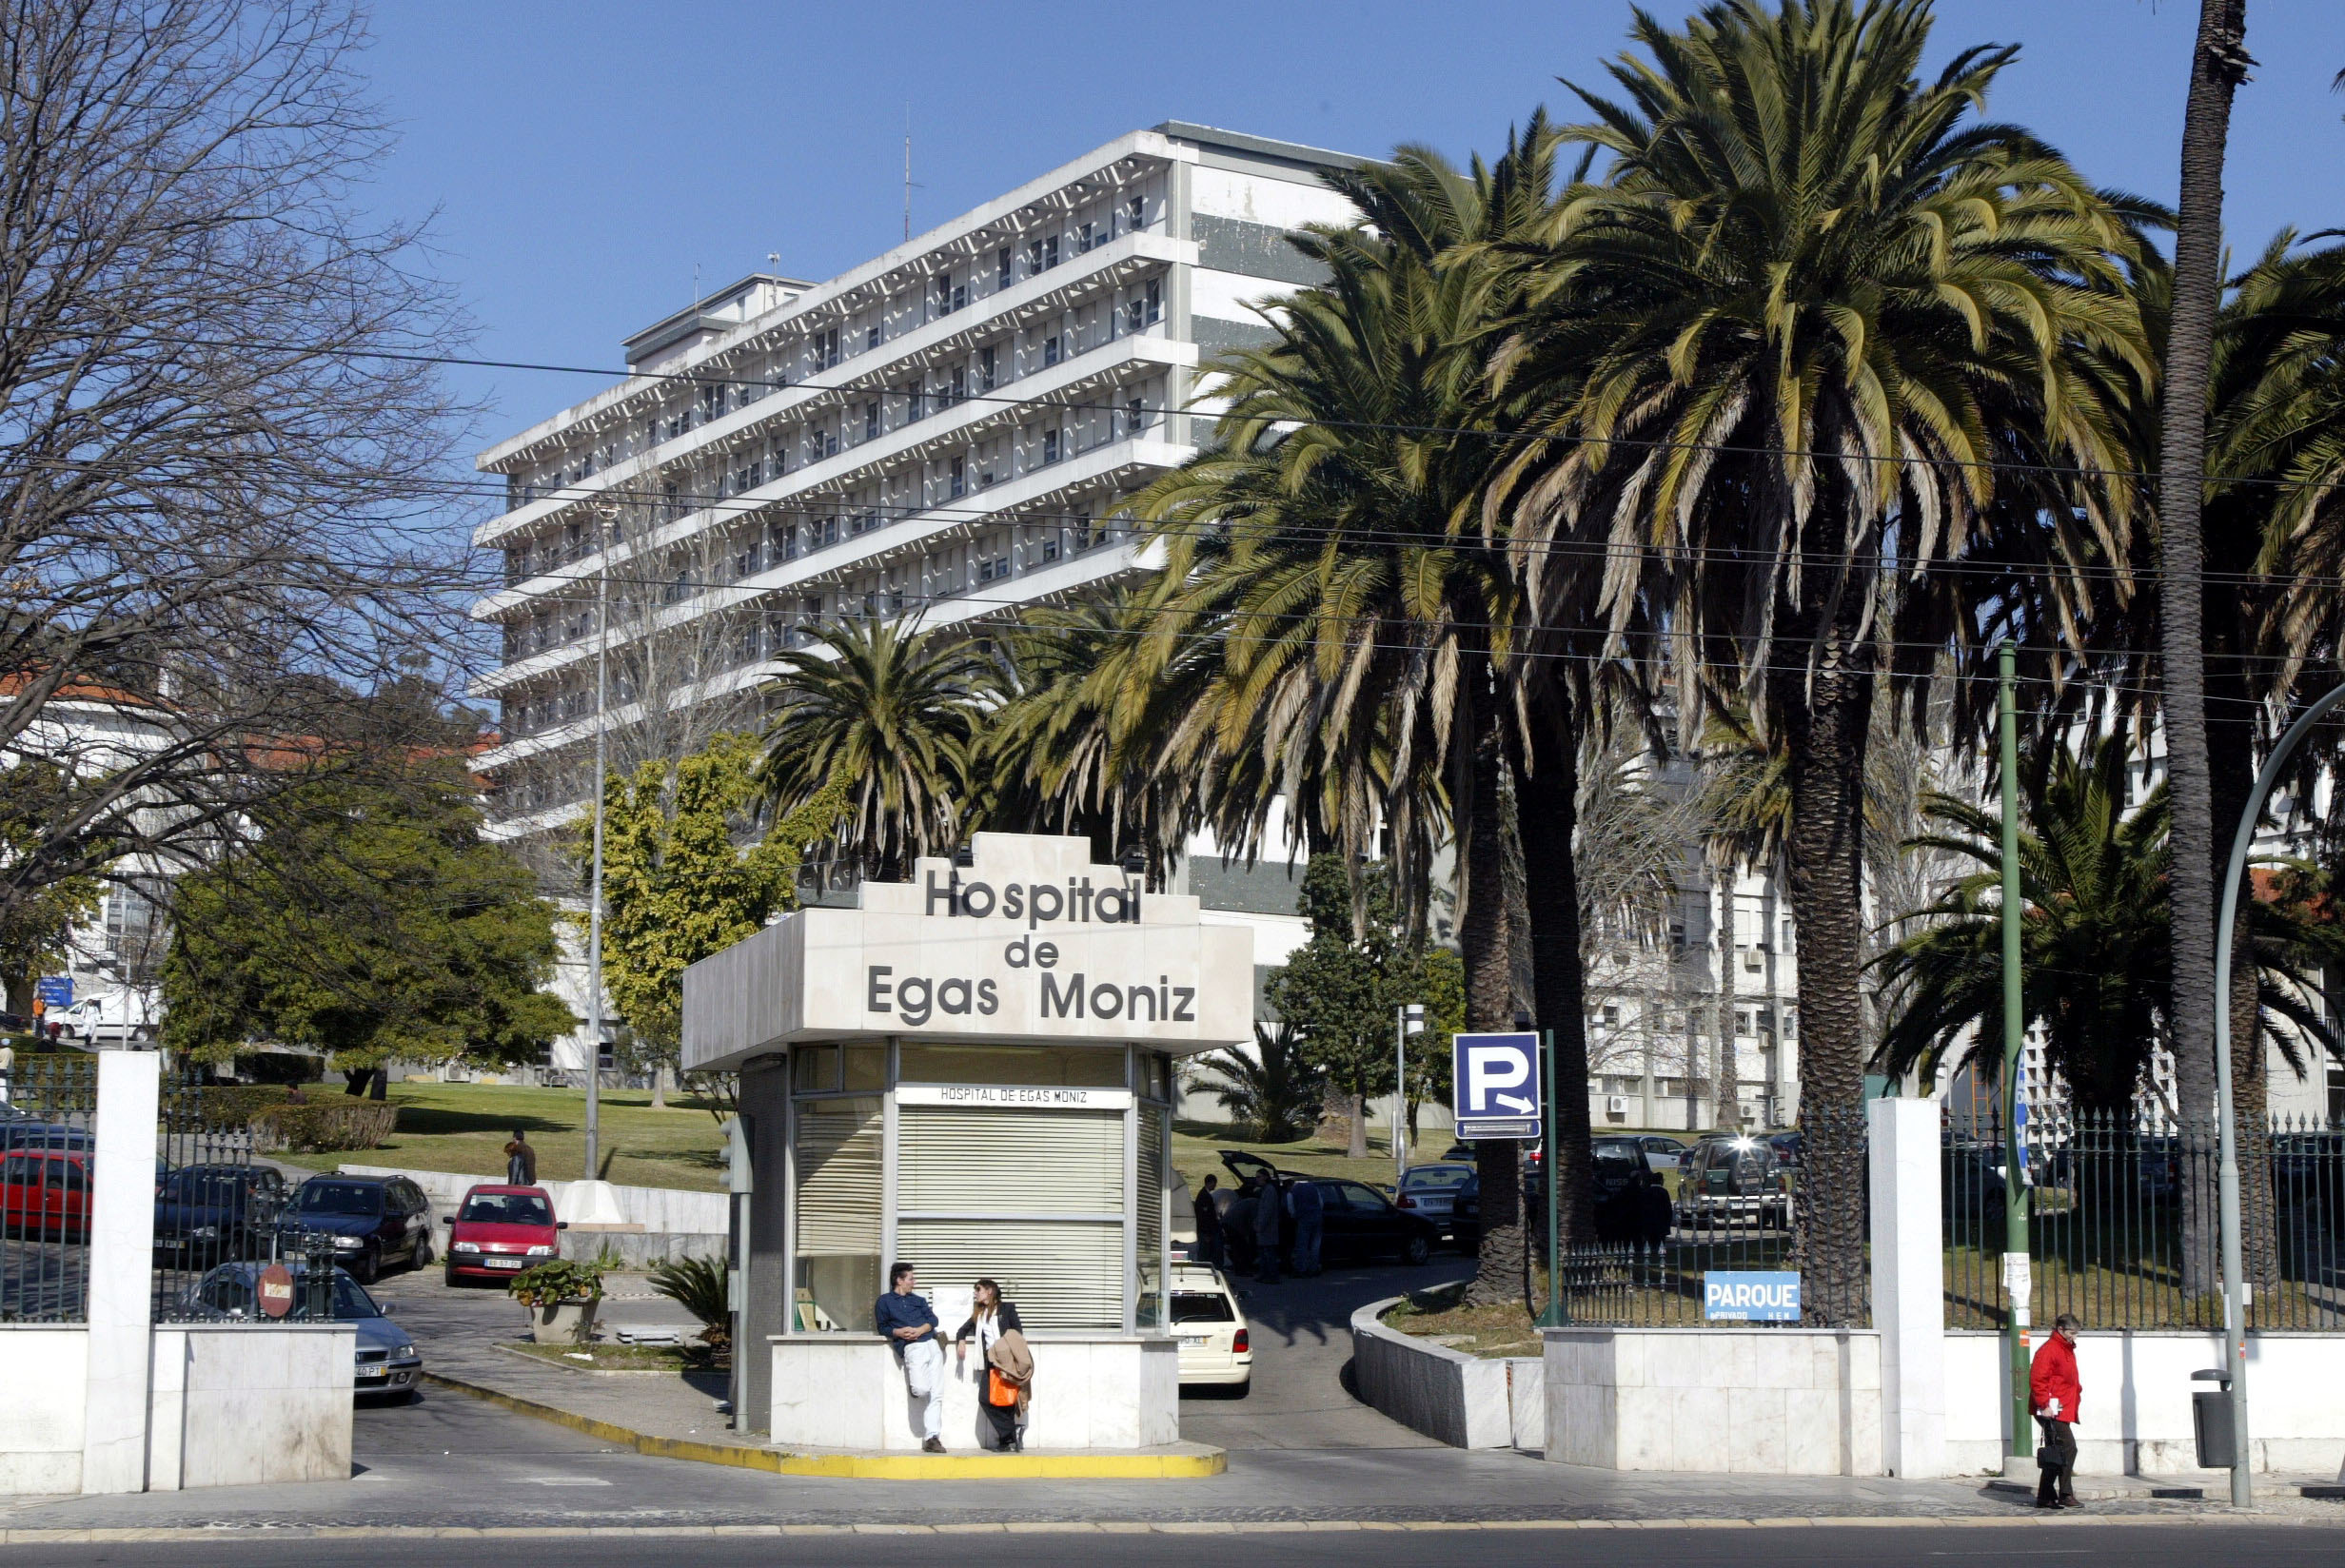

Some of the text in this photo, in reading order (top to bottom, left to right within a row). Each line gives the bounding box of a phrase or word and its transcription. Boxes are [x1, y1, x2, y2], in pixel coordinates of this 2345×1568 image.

[925, 870, 1141, 931] Hospital
[1004, 934, 1059, 969] de
[867, 965, 1195, 1027] Egas Moniz
[940, 1088, 1087, 1104] HOSPITAL DE EGAS MONIZ
[1468, 1046, 1529, 1111] P
[1706, 1283, 1798, 1309] PARQUE
